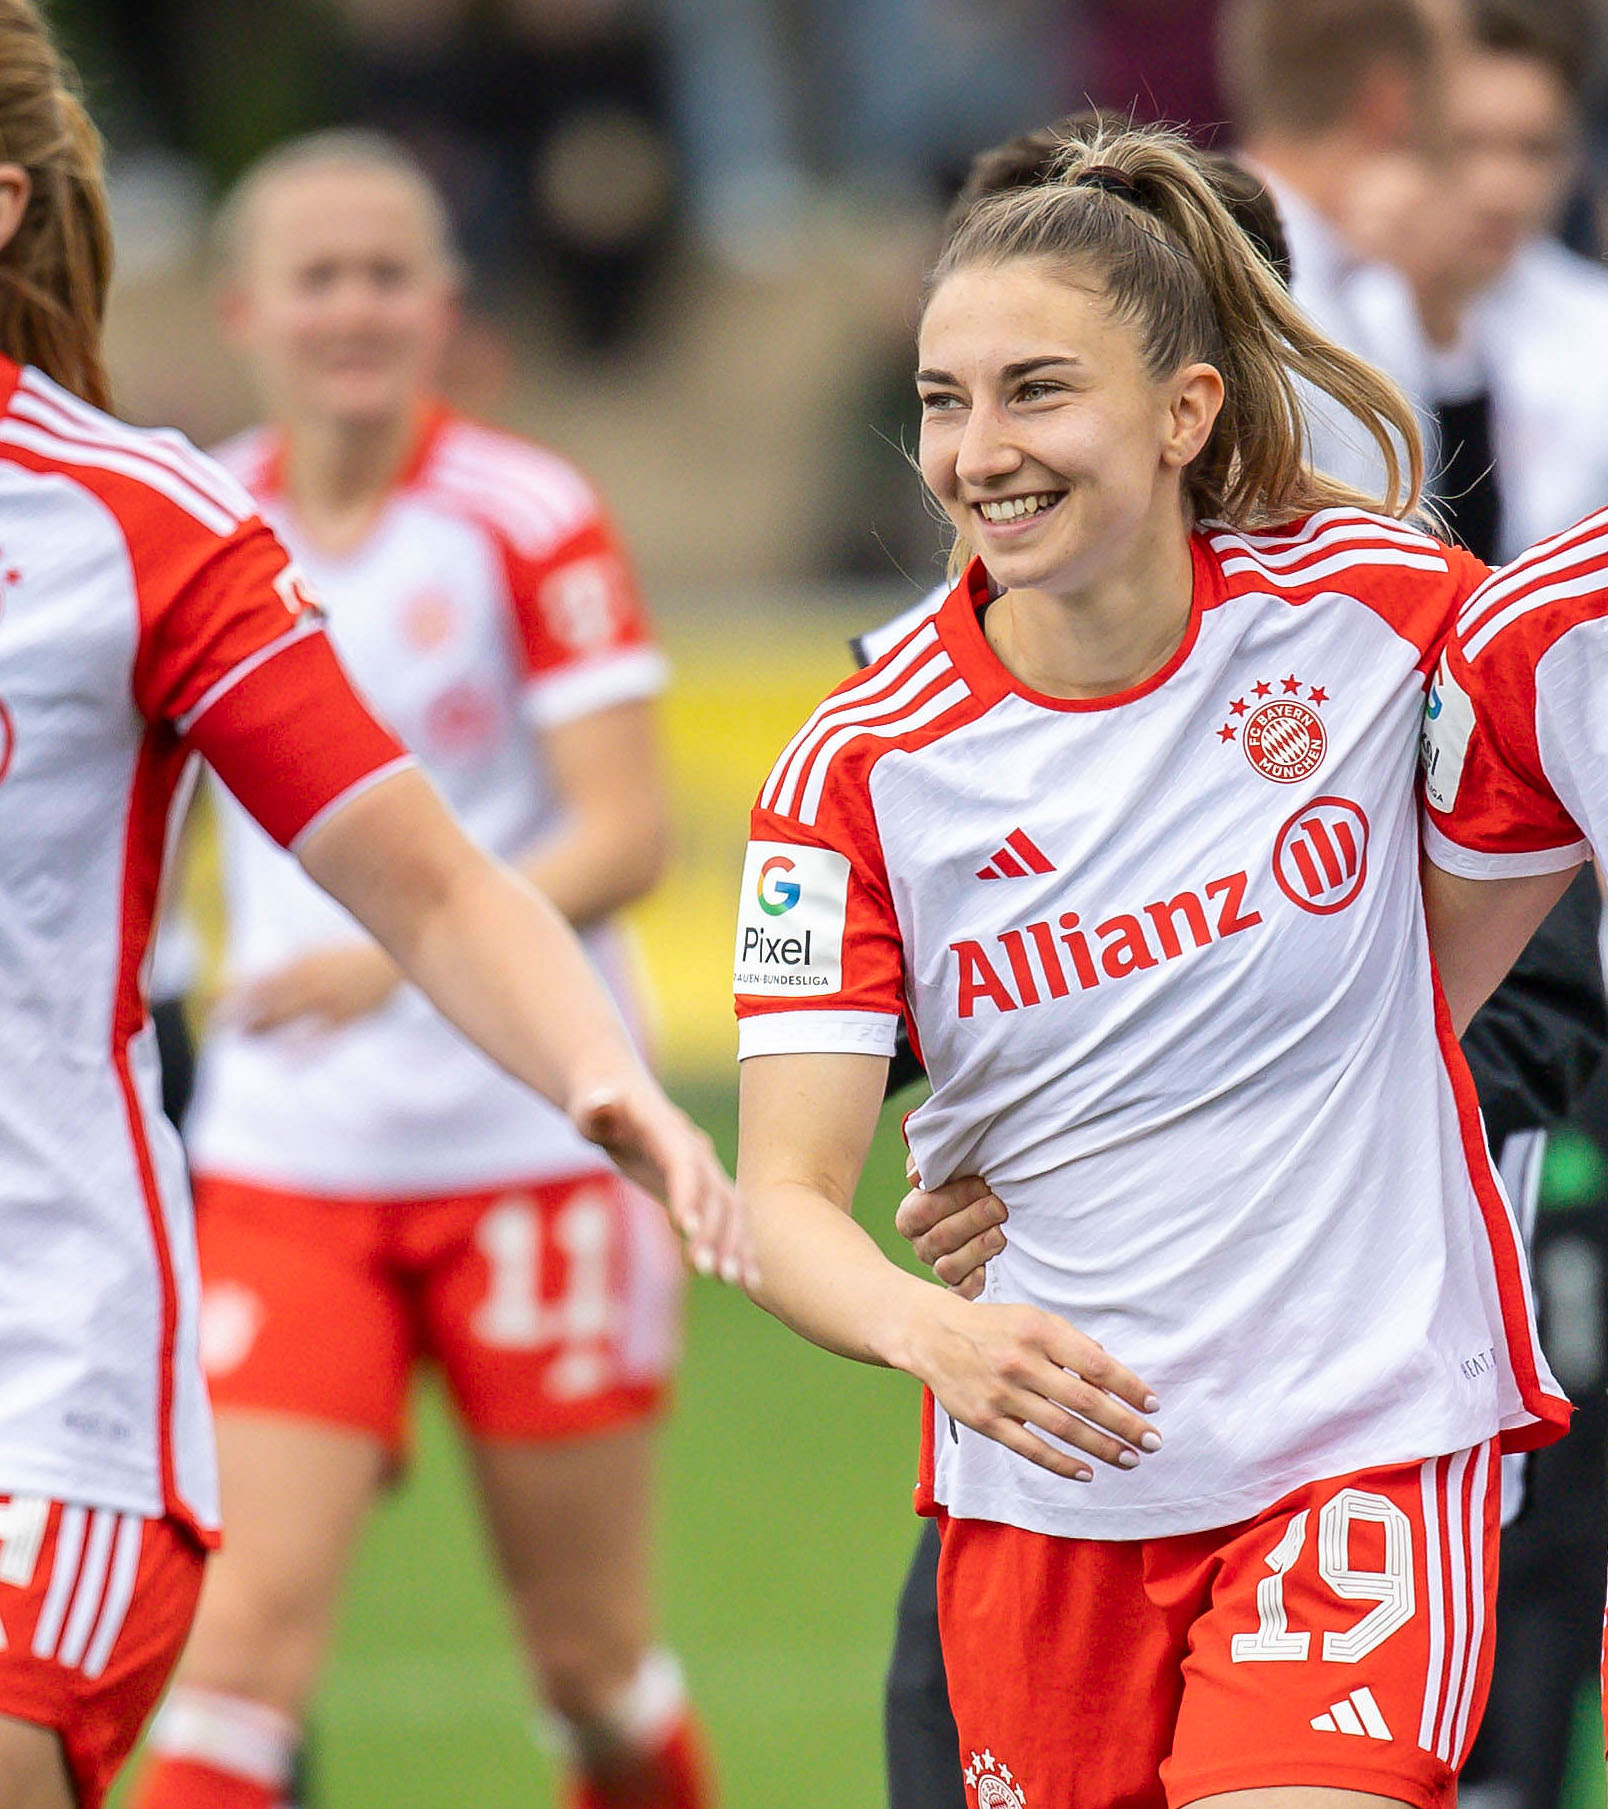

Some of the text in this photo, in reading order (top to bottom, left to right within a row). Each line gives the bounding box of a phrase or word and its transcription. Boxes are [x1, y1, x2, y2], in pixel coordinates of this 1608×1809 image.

[1249, 705, 1314, 746] FC BAYERN
[1259, 739, 1322, 778] MÜNCHEN
[757, 856, 801, 917] G
[742, 926, 811, 966] Pixel
[950, 868, 1263, 1020] Allianz
[1230, 1487, 1417, 1665] 19
